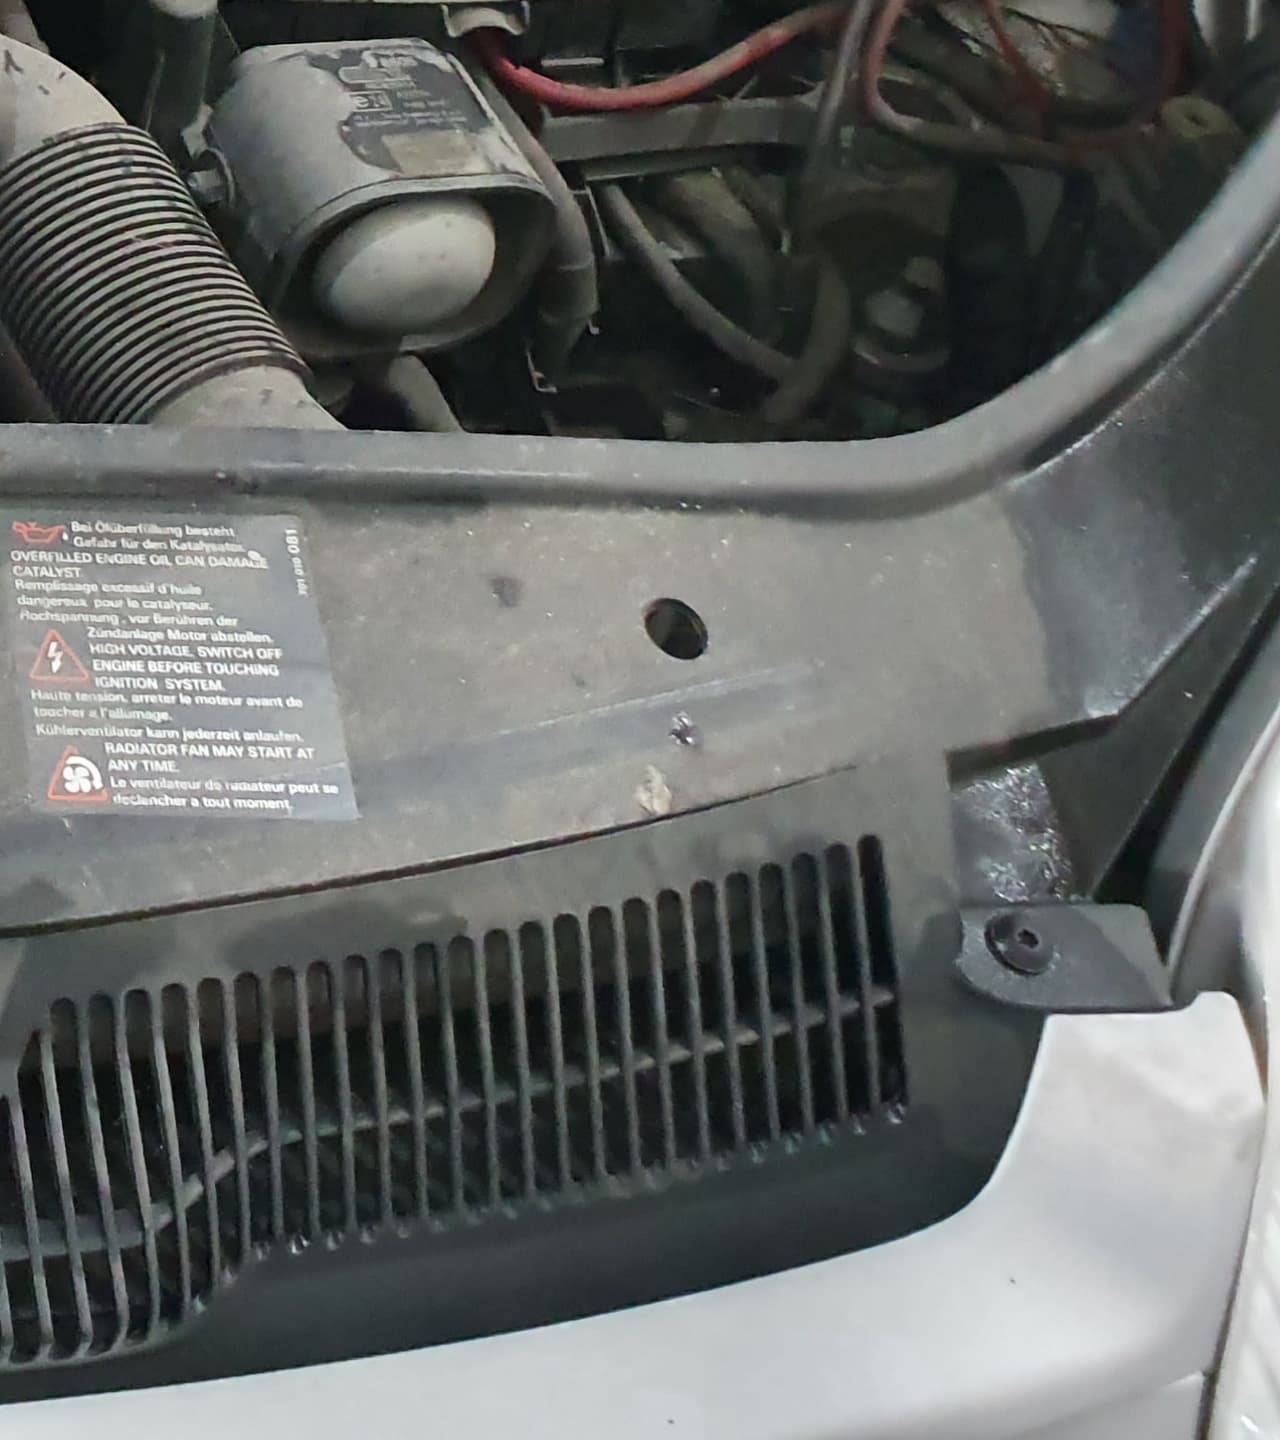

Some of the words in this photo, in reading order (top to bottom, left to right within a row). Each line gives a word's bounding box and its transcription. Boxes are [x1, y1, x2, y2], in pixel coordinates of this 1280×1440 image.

[71, 521, 92, 533] Bei
[185, 525, 235, 537] besteht
[73, 536, 117, 548] Gefahr
[121, 538, 139, 549] für
[142, 539, 168, 549] den
[10, 550, 92, 563] OVERFILLED
[96, 553, 147, 565] ENGINE
[149, 554, 173, 566] OIL
[175, 555, 206, 567] CAN
[208, 556, 269, 569] DAMAGE
[12, 565, 82, 578] CATALYST
[14, 579, 98, 594] Remplissage
[101, 582, 155, 593] excessif
[17, 595, 87, 608] dangereux
[94, 599, 124, 609] pour
[127, 597, 141, 608] le
[128, 614, 150, 624] vor
[153, 613, 213, 626] Berühren
[216, 615, 238, 626] der
[87, 626, 164, 642] Zündanlage
[167, 629, 207, 641] Motor
[90, 643, 126, 655] HIGH
[197, 647, 254, 659] SWITCH
[256, 648, 283, 660] OFF
[93, 659, 145, 672] ENGINE
[148, 661, 203, 674] BEFORE
[205, 662, 280, 677] TOUCHING
[95, 676, 158, 689] IGNITION
[165, 679, 226, 692] SYSTEM.
[31, 689, 72, 701] Haute
[179, 693, 191, 705] le
[195, 695, 243, 706] moteur
[246, 697, 283, 707] avant
[286, 696, 303, 708] de
[34, 706, 85, 718] toucher
[36, 724, 144, 737] Kühlerventilator
[146, 726, 180, 739] kann
[182, 728, 240, 742] jederzeit
[104, 742, 177, 756] RADIATOR
[181, 744, 209, 757] FAN
[212, 745, 244, 757] MAY
[248, 747, 294, 758] START
[297, 748, 315, 759] AT
[108, 759, 138, 772] ANY
[110, 776, 126, 788] Le
[129, 777, 200, 790] ventilateur
[205, 779, 222, 791] de
[226, 781, 285, 793] radiateur
[289, 783, 320, 795] peut
[322, 785, 339, 794] se
[202, 798, 230, 808] tout
